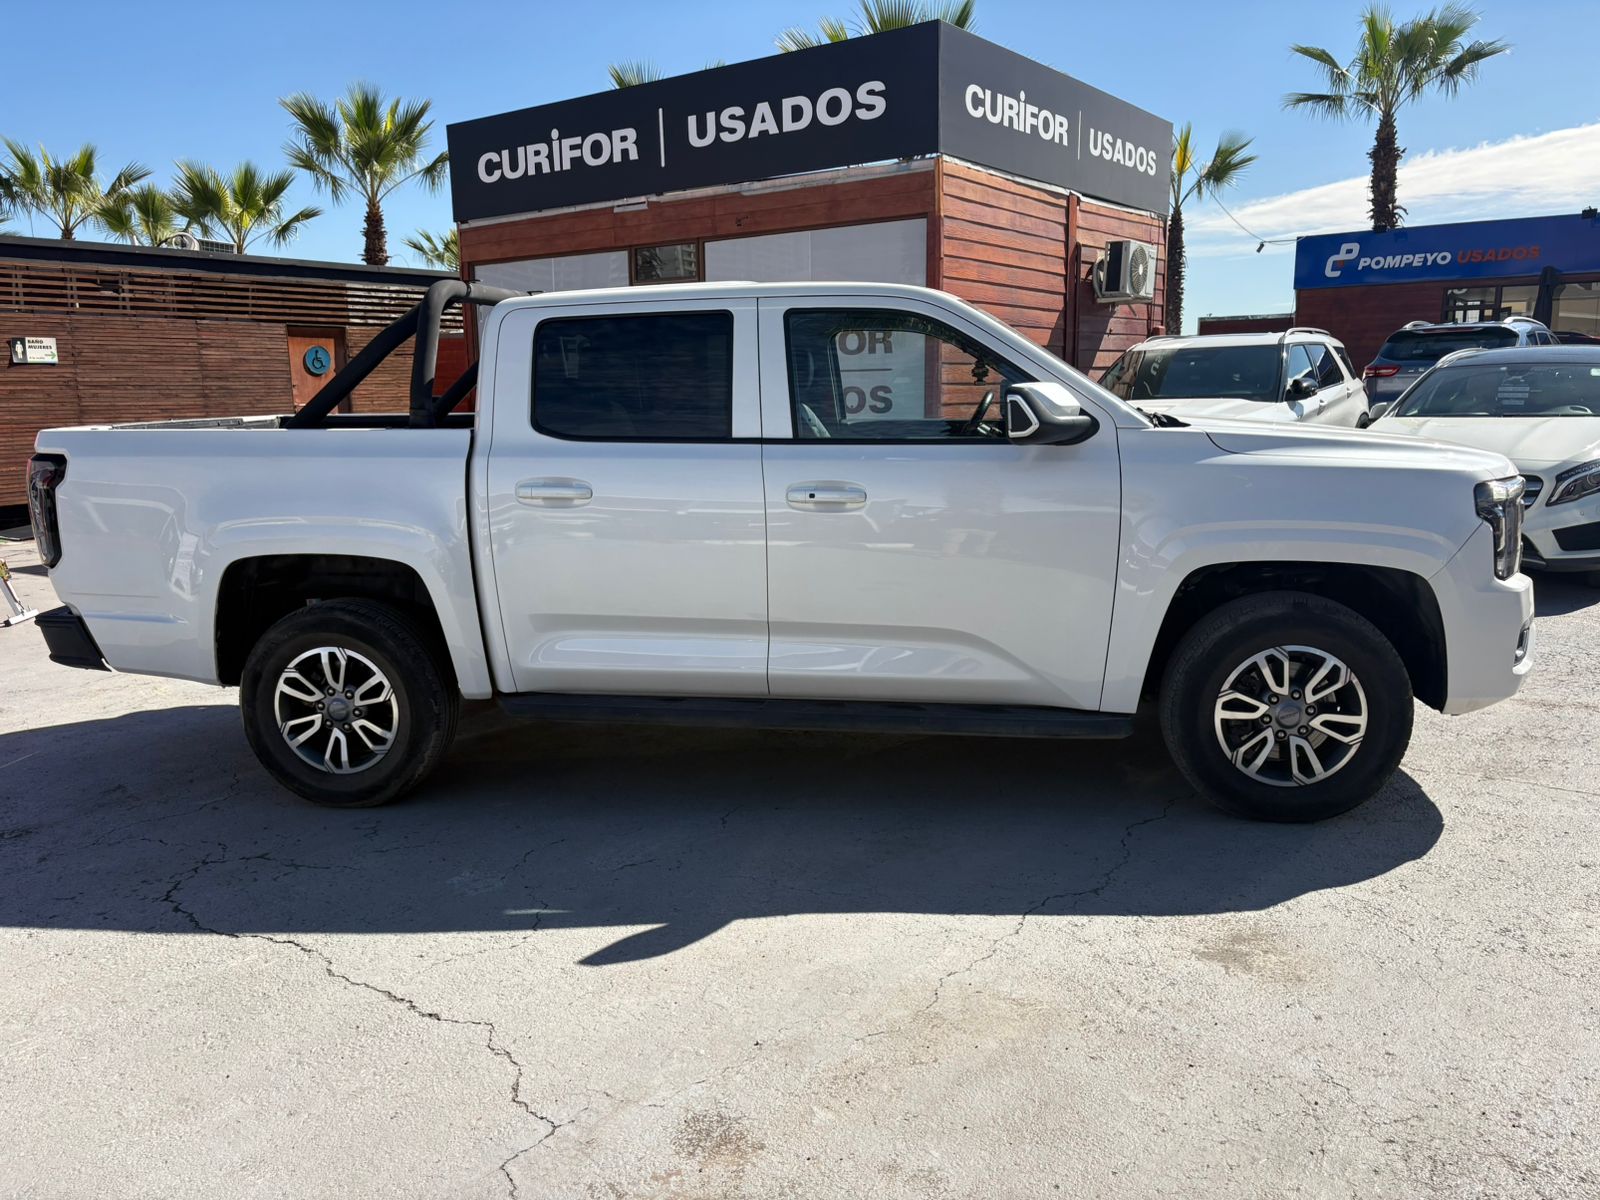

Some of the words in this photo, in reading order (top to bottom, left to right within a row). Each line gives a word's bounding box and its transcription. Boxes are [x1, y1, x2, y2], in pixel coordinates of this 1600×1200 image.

[687, 80, 887, 148] USADOS
[1088, 128, 1157, 177] USADOS
[1357, 251, 1452, 271] POMPEYO
[1457, 245, 1541, 264] USADOS
